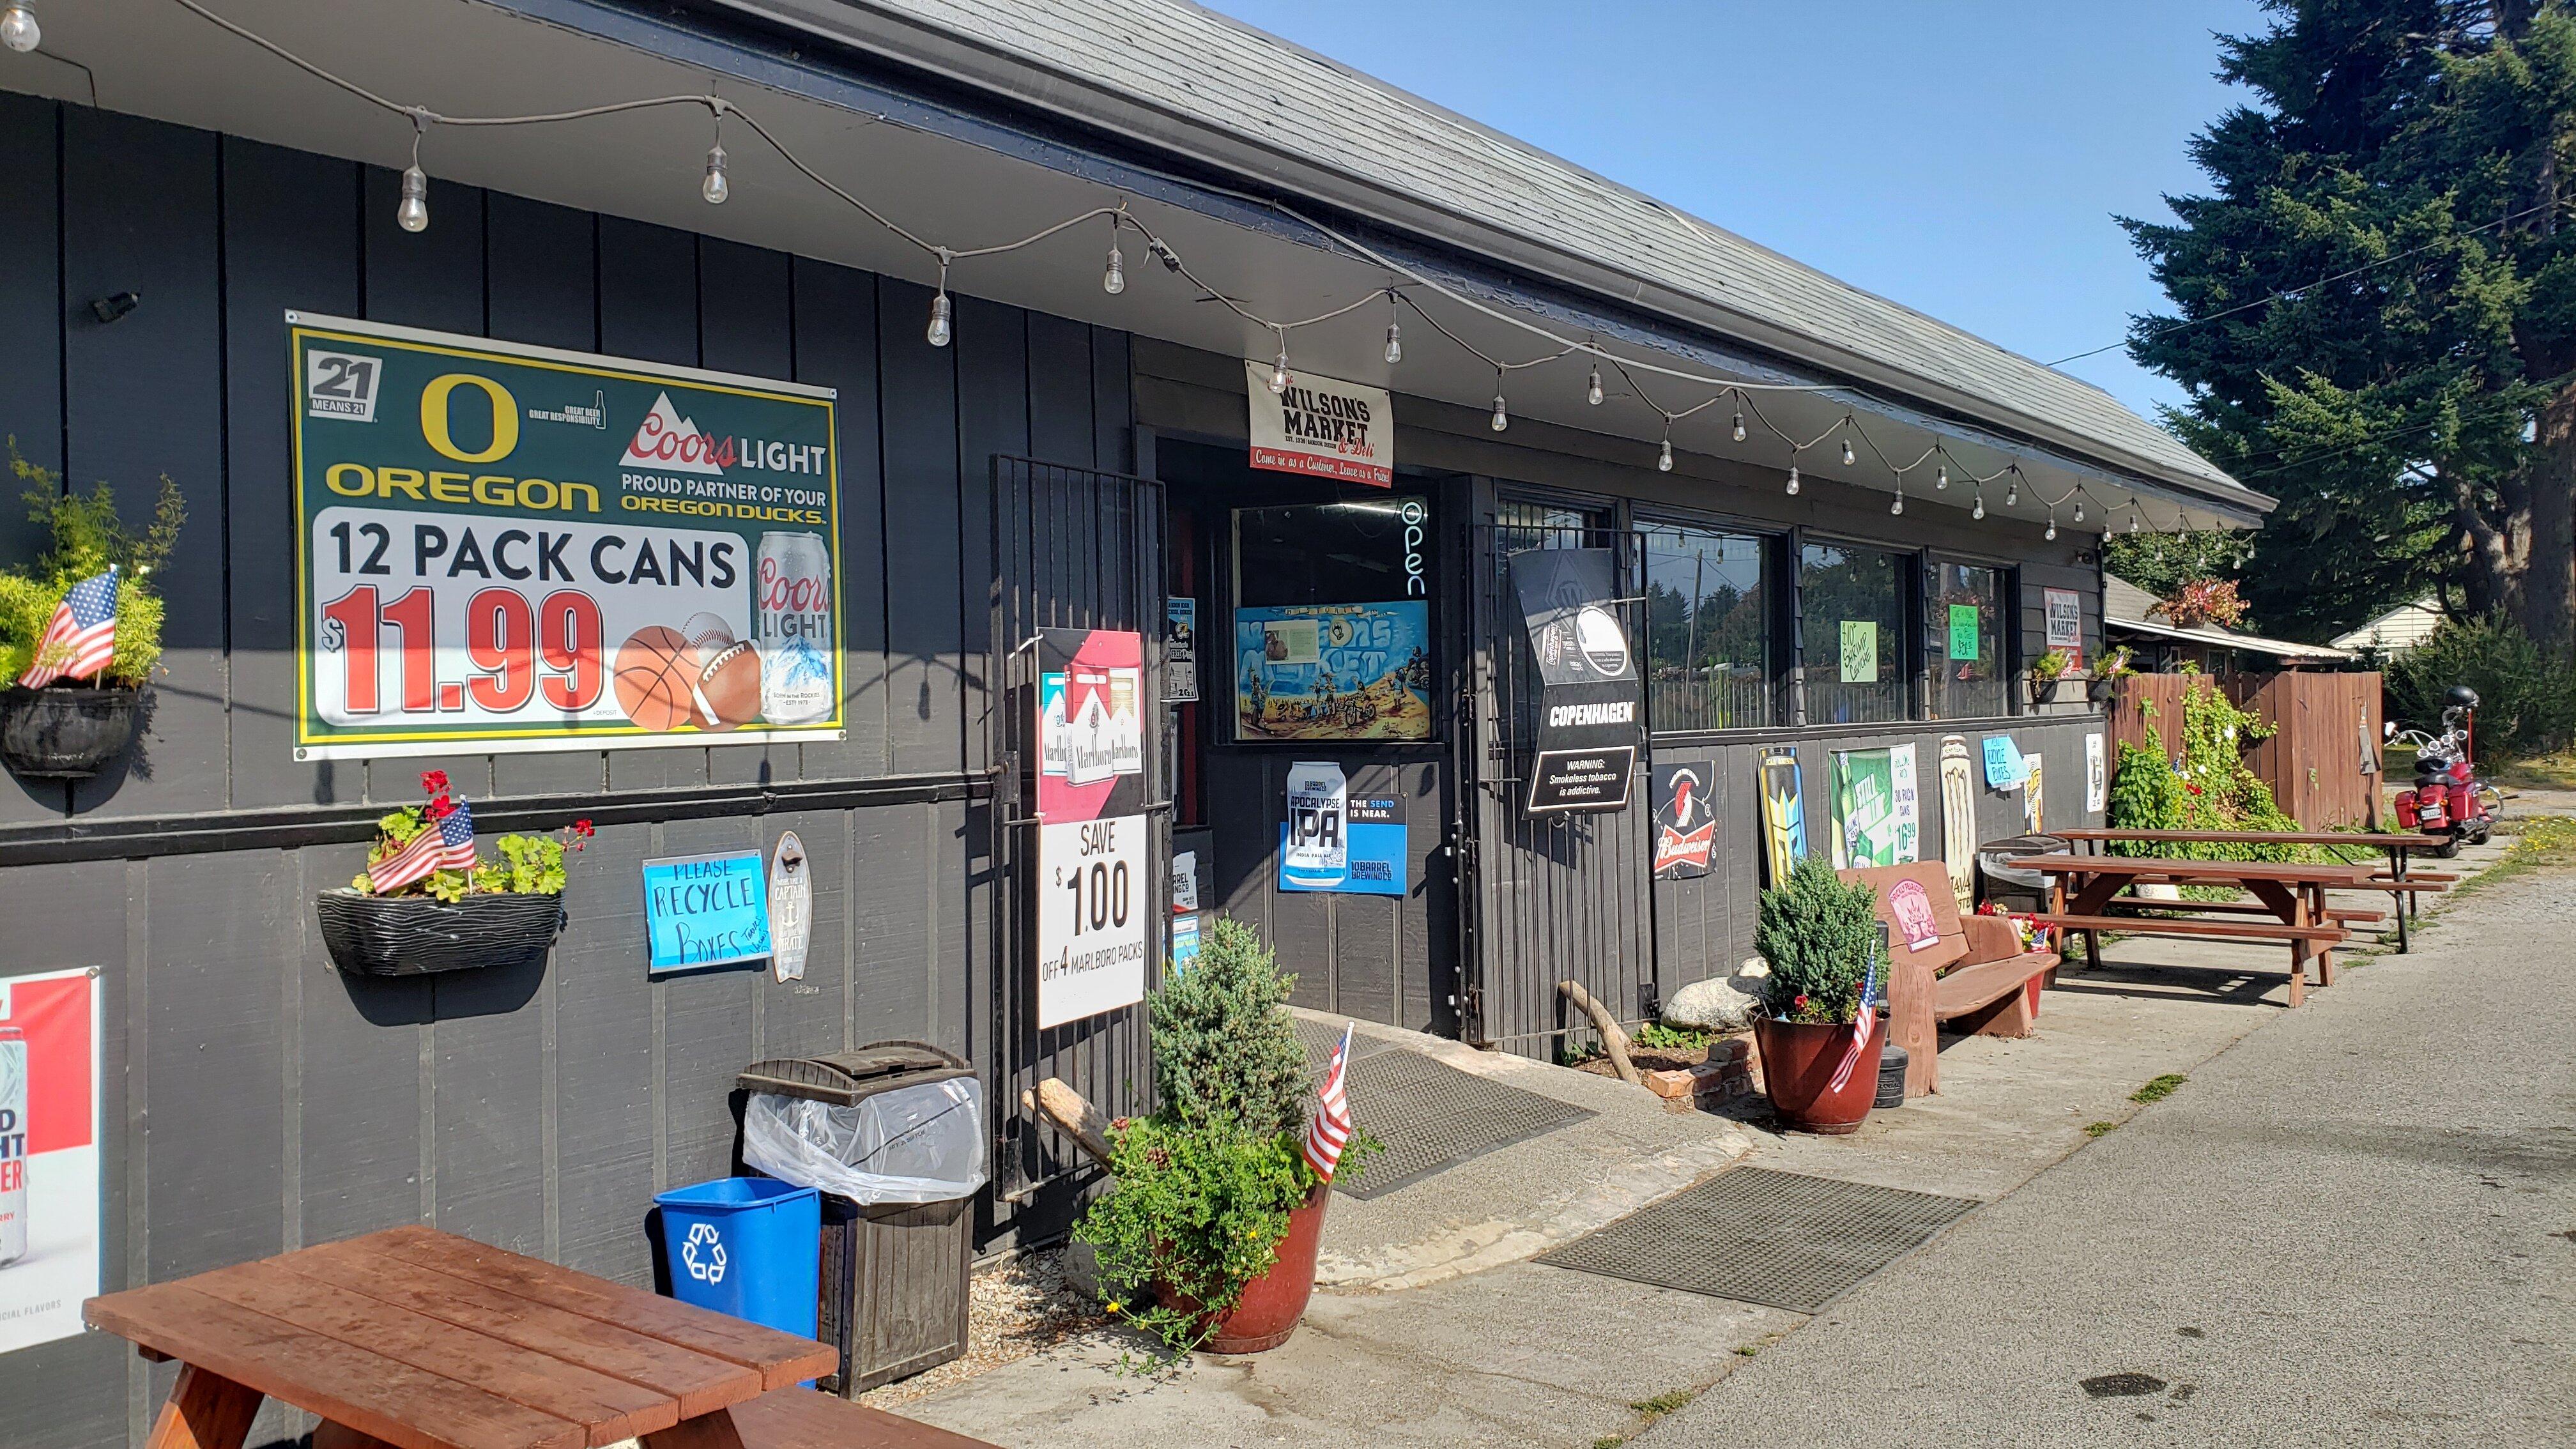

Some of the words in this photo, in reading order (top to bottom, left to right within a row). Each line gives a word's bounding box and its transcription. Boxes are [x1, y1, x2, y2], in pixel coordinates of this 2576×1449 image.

[312, 357, 372, 400] 21
[312, 397, 351, 413] MEANS
[351, 401, 364, 415] 21
[565, 405, 585, 415] GREAT
[1279, 386, 1370, 422] WILSON'S
[529, 409, 549, 420] GREAT
[551, 411, 601, 425] RESPONSIBILITY
[1284, 409, 1368, 447] MARKET
[629, 412, 737, 467] Coors
[742, 438, 827, 475] LIGHT
[1338, 437, 1347, 454] &
[1350, 438, 1375, 458] Deli
[1255, 448, 1276, 466] Come
[1278, 453, 1285, 466] in
[1288, 457, 1297, 468] as
[1300, 461, 1304, 469] a
[1307, 456, 1338, 475] Customer,
[1339, 462, 1358, 477] Leave
[1359, 470, 1365, 479] as
[1374, 468, 1390, 483] Friend
[326, 463, 600, 512] OREGON
[622, 473, 682, 494] PROUD
[687, 479, 758, 501] PARTNER
[761, 486, 782, 503] OF
[784, 489, 827, 507] YOUR
[621, 495, 733, 518] OREGON
[330, 521, 390, 575] 12
[416, 526, 575, 582] PACK
[590, 534, 736, 589] CANS
[764, 612, 826, 638] LIGHT
[2050, 619, 2077, 636] MARKET
[321, 583, 604, 716] $11.99
[1843, 631, 1867, 668] SHRIMP
[1549, 702, 1633, 727] COPENHAGEN
[1567, 758, 1606, 770] WARNING:
[1549, 774, 1587, 785] Smokeless
[1588, 772, 1616, 781] tobacco
[1291, 795, 1340, 809] APOCALYPSE
[1559, 786, 1567, 796] is
[1567, 785, 1601, 795] addictive.
[1894, 789, 1901, 802] 30
[1902, 788, 1915, 801] PACK
[1350, 799, 1367, 808] THE
[1350, 809, 1359, 818] IS
[1361, 809, 1390, 818] NEAR.
[1899, 804, 1910, 816] CANS
[1080, 820, 1116, 856] SAVE
[1291, 808, 1340, 848] IPA
[1657, 834, 1711, 860] Budweiser
[674, 859, 733, 881] PLEASE
[654, 877, 755, 917] RECYCLE
[774, 884, 806, 901] CAPTAIN
[777, 935, 804, 953] PIRATE
[1042, 960, 1059, 982] OFF
[1060, 946, 1068, 976] 4
[1071, 947, 1117, 976] MARLBORO
[1118, 940, 1143, 963] PACKS
[24, 1299, 62, 1315] FLAVORS
